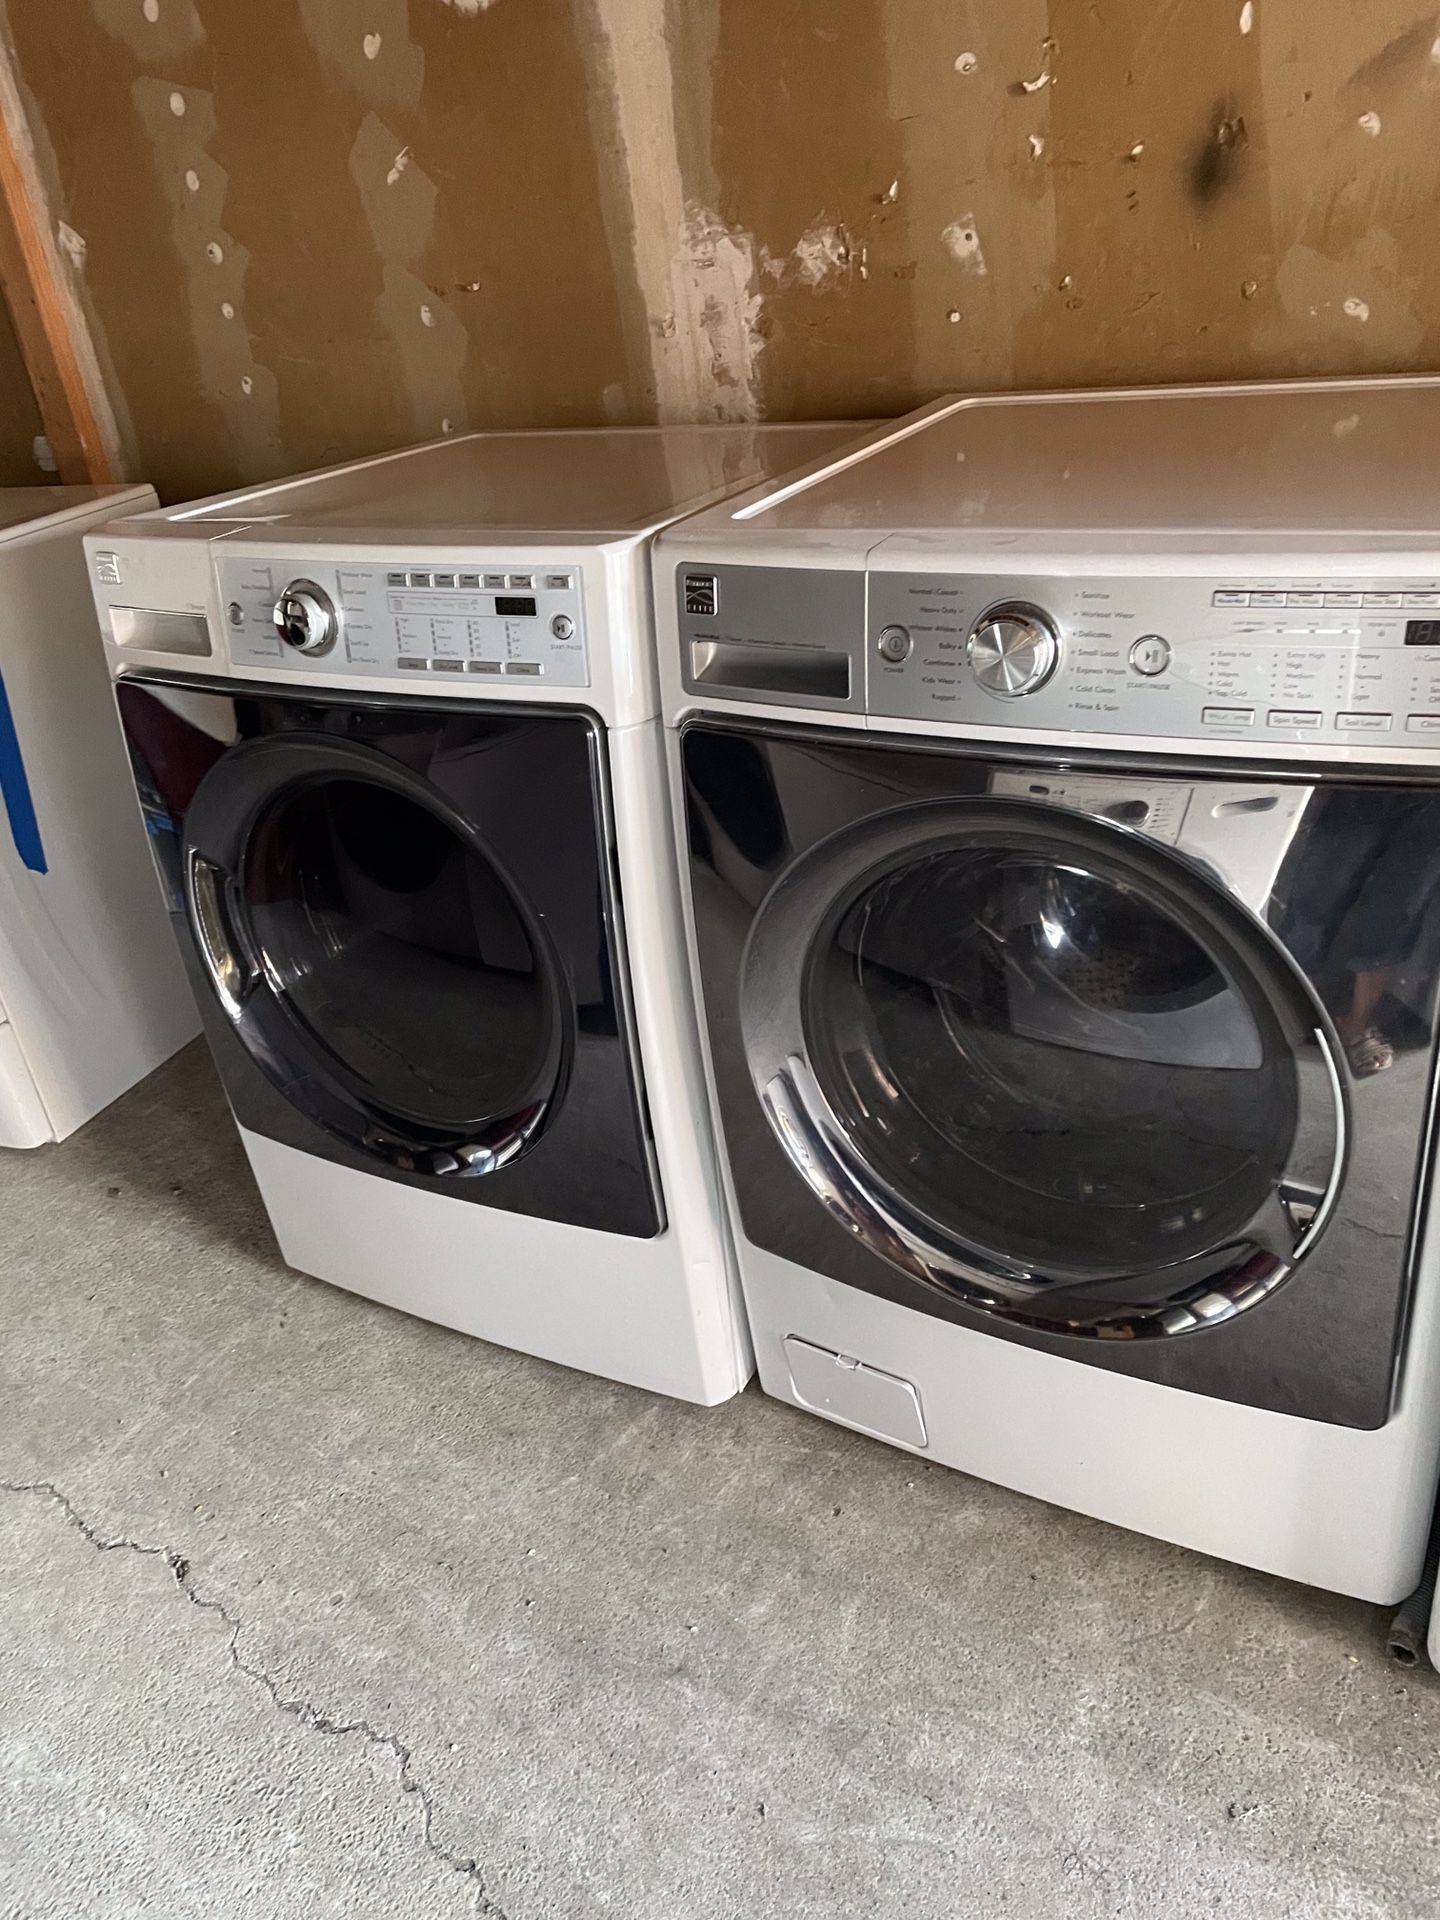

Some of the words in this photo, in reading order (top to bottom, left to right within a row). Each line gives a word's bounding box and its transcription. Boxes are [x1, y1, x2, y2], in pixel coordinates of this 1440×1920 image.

[1100, 649, 1121, 657] Load
[1075, 666, 1104, 675] Express
[1075, 684, 1093, 692] Cold
